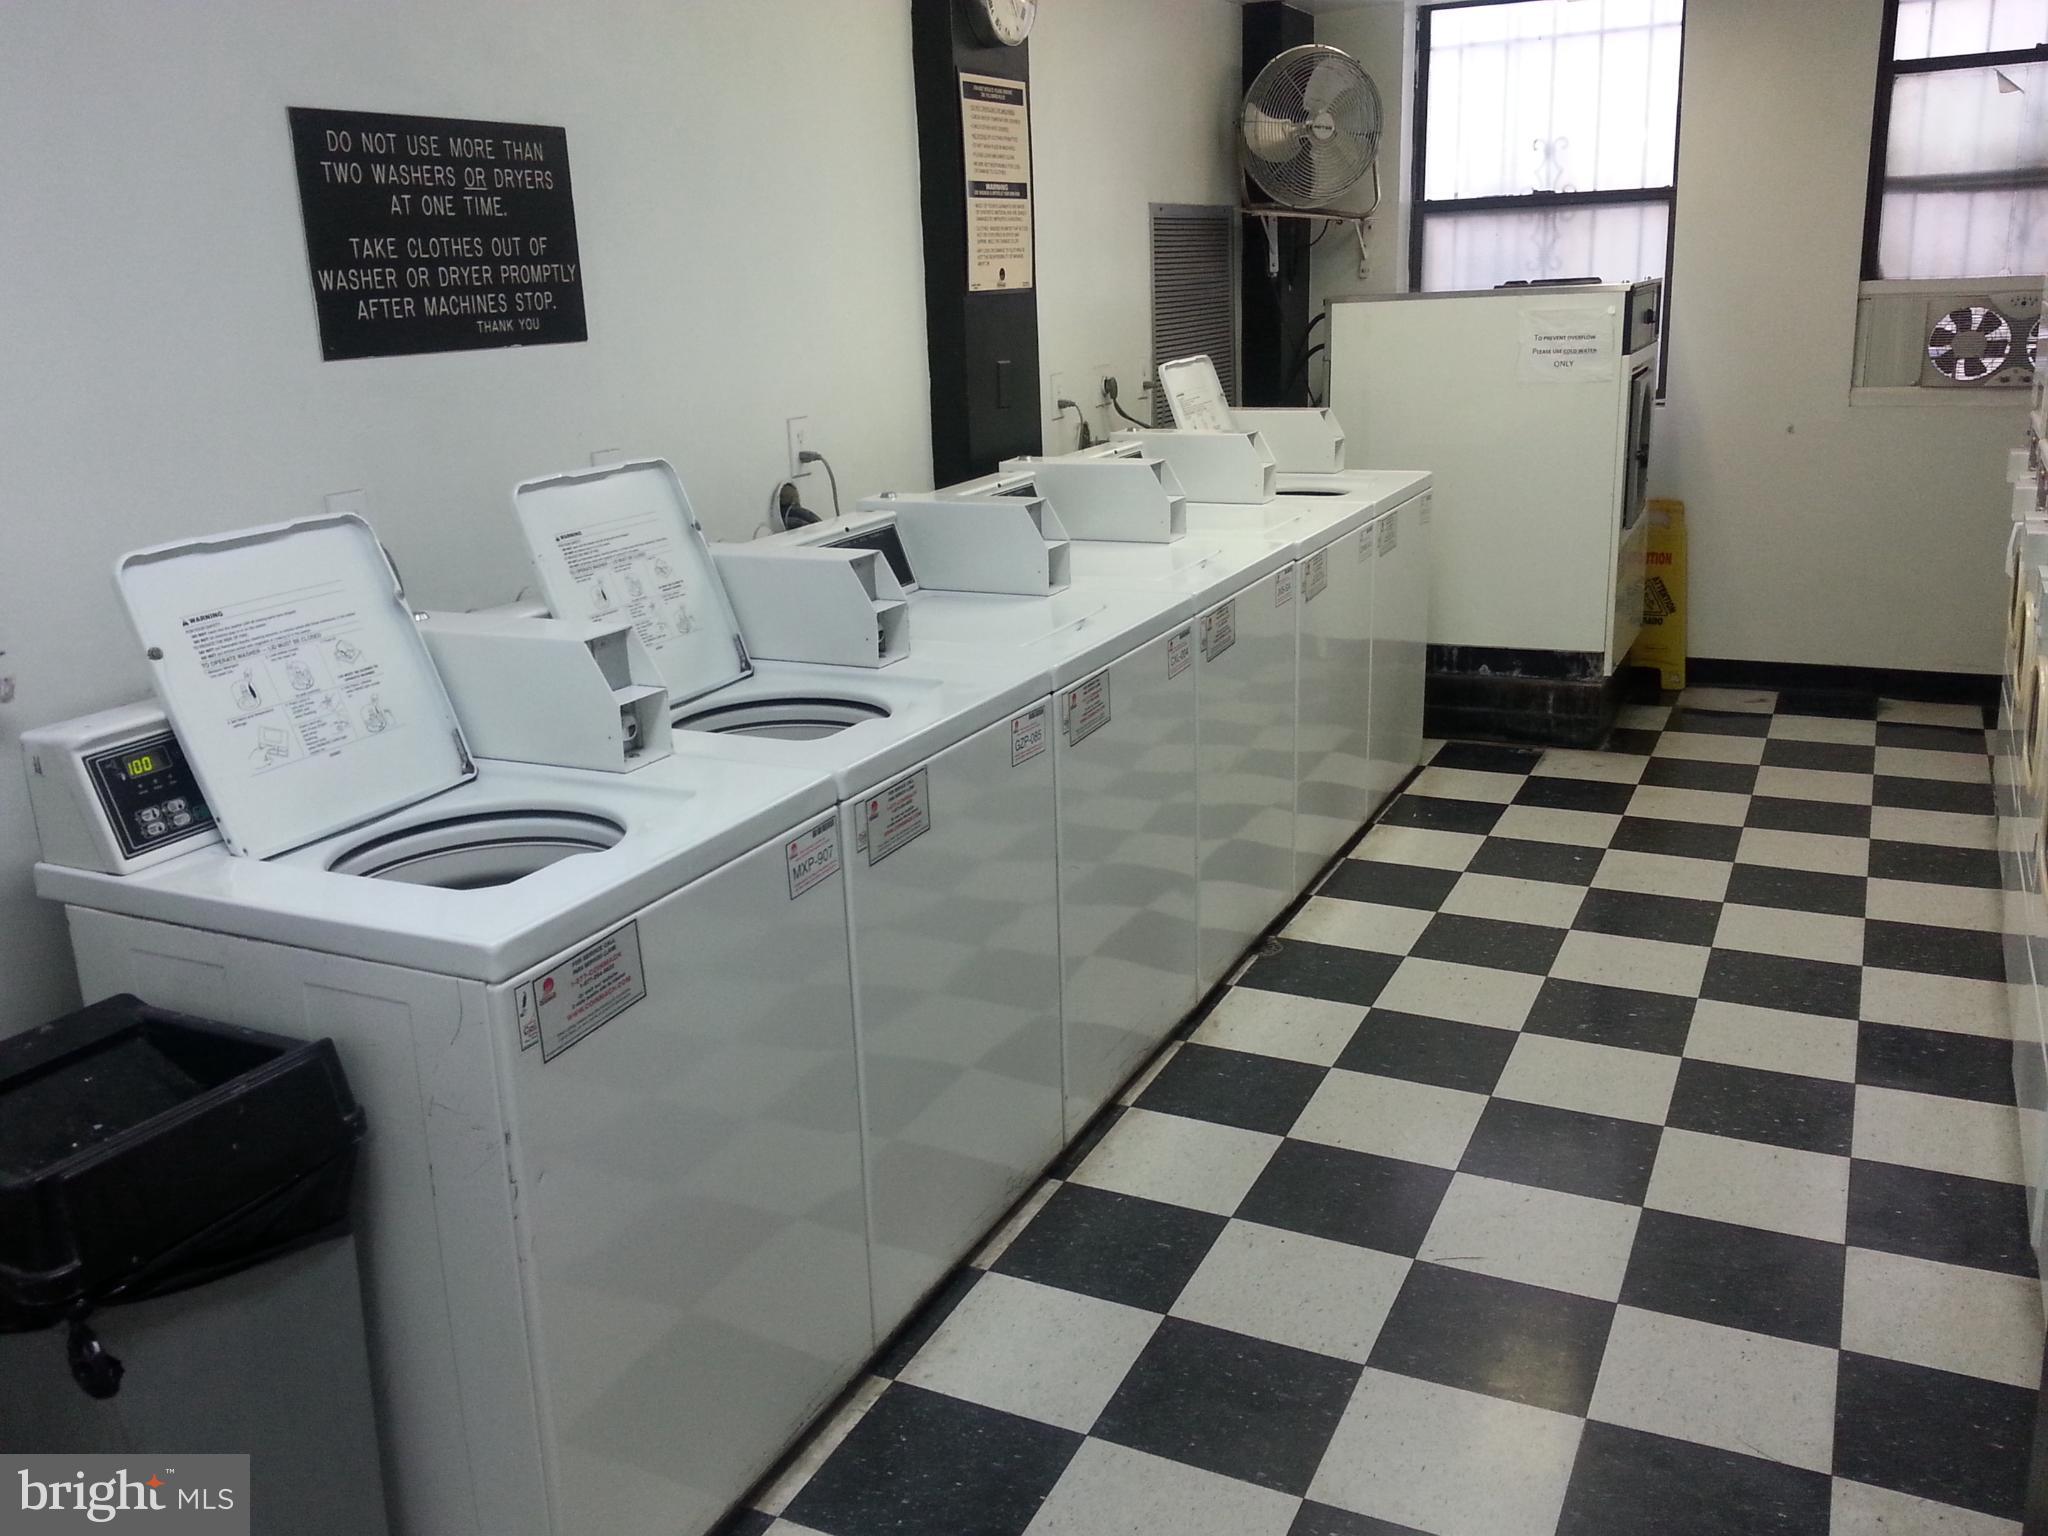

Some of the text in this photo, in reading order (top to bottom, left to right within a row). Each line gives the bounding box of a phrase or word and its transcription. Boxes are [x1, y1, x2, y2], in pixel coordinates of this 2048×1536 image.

[326, 130, 544, 161] DO NOT USE MORE THAN
[320, 161, 554, 190] TWO WASHERS OR DRYERS
[391, 195, 508, 217] AT ONE TIME.
[349, 237, 549, 259] TAKE CLOTHES OUT OF
[318, 264, 577, 292] WASHER OR DRYER PROMPTLY
[357, 292, 557, 321] AFTER MACHINES STOP.
[477, 318, 540, 334] THANK YOU
[1553, 360, 1574, 368] ONLY
[189, 611, 223, 625] WARNING
[128, 756, 153, 776] 100
[792, 844, 834, 881] MXP-907
